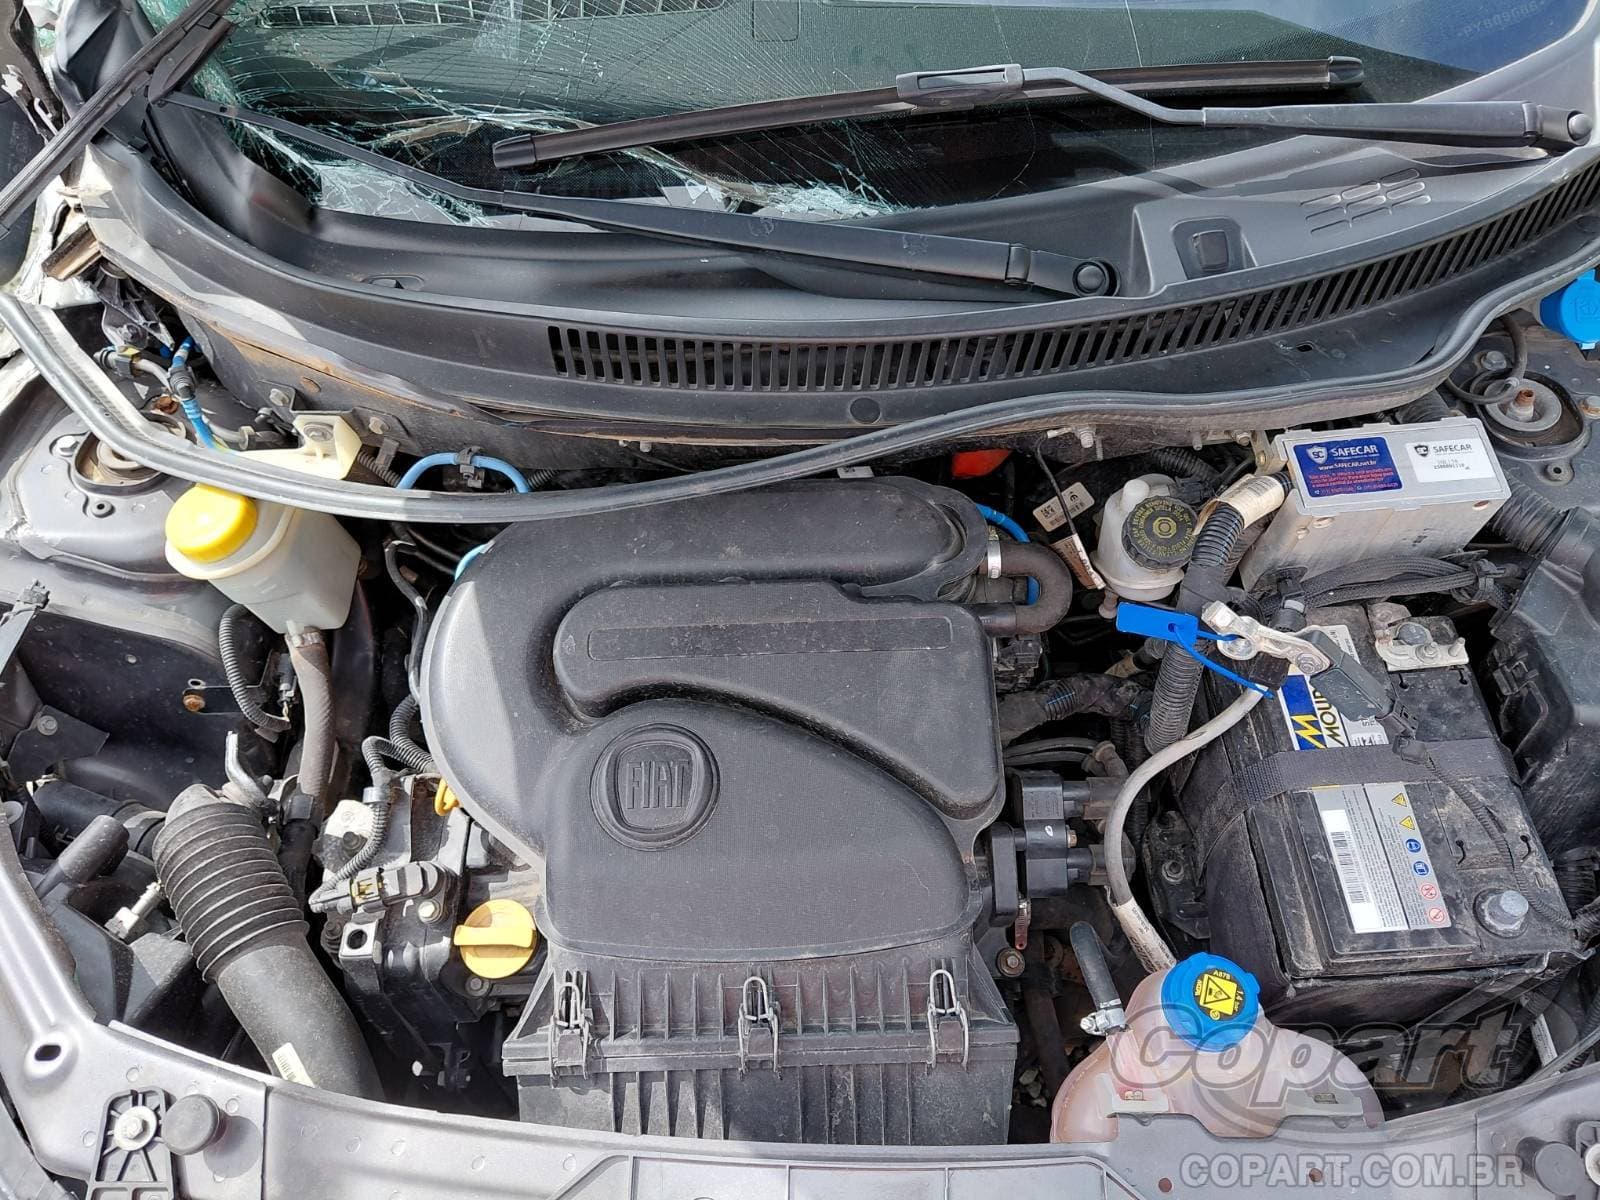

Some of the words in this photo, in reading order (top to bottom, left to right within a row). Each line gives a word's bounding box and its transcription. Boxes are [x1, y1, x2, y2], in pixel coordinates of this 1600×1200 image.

[1332, 444, 1379, 457] SAFECAR
[1433, 443, 1473, 452] SAFECAR
[626, 759, 691, 810] FIAT
